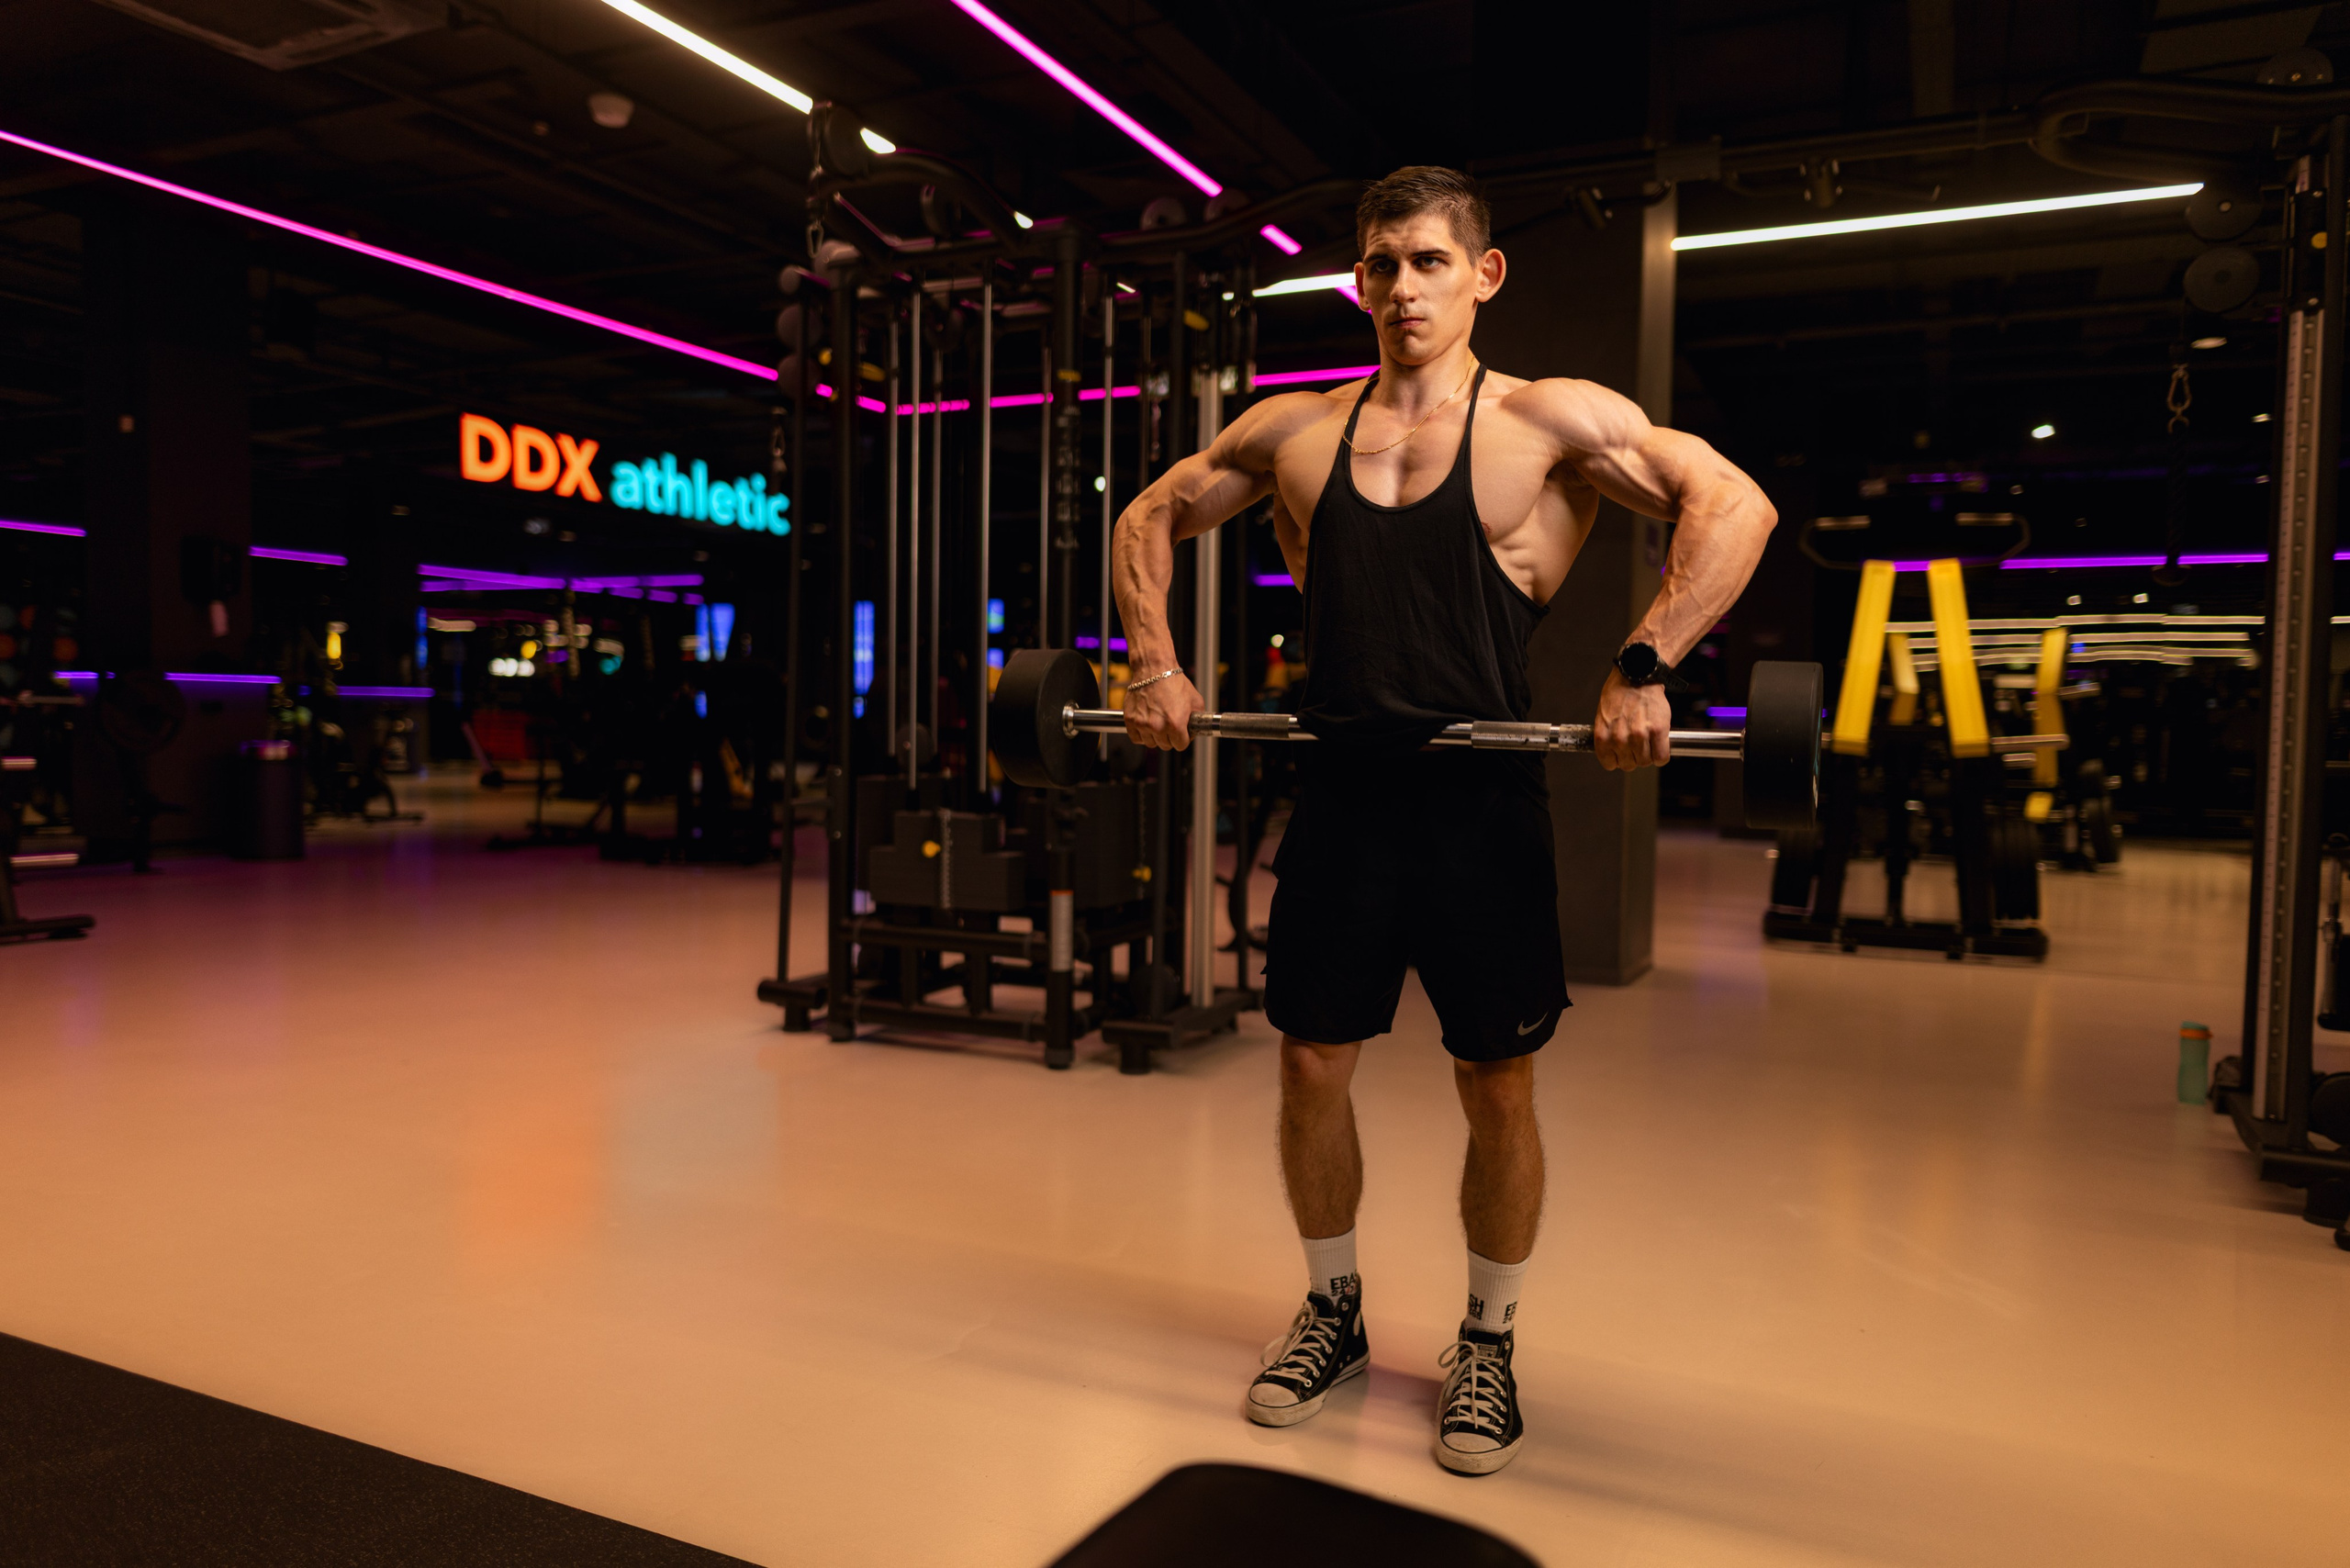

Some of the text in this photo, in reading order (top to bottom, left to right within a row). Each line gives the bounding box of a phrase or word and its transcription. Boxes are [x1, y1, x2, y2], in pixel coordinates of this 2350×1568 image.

[460, 411, 791, 537] DDX athletic
[1330, 1271, 1357, 1290] EBA
